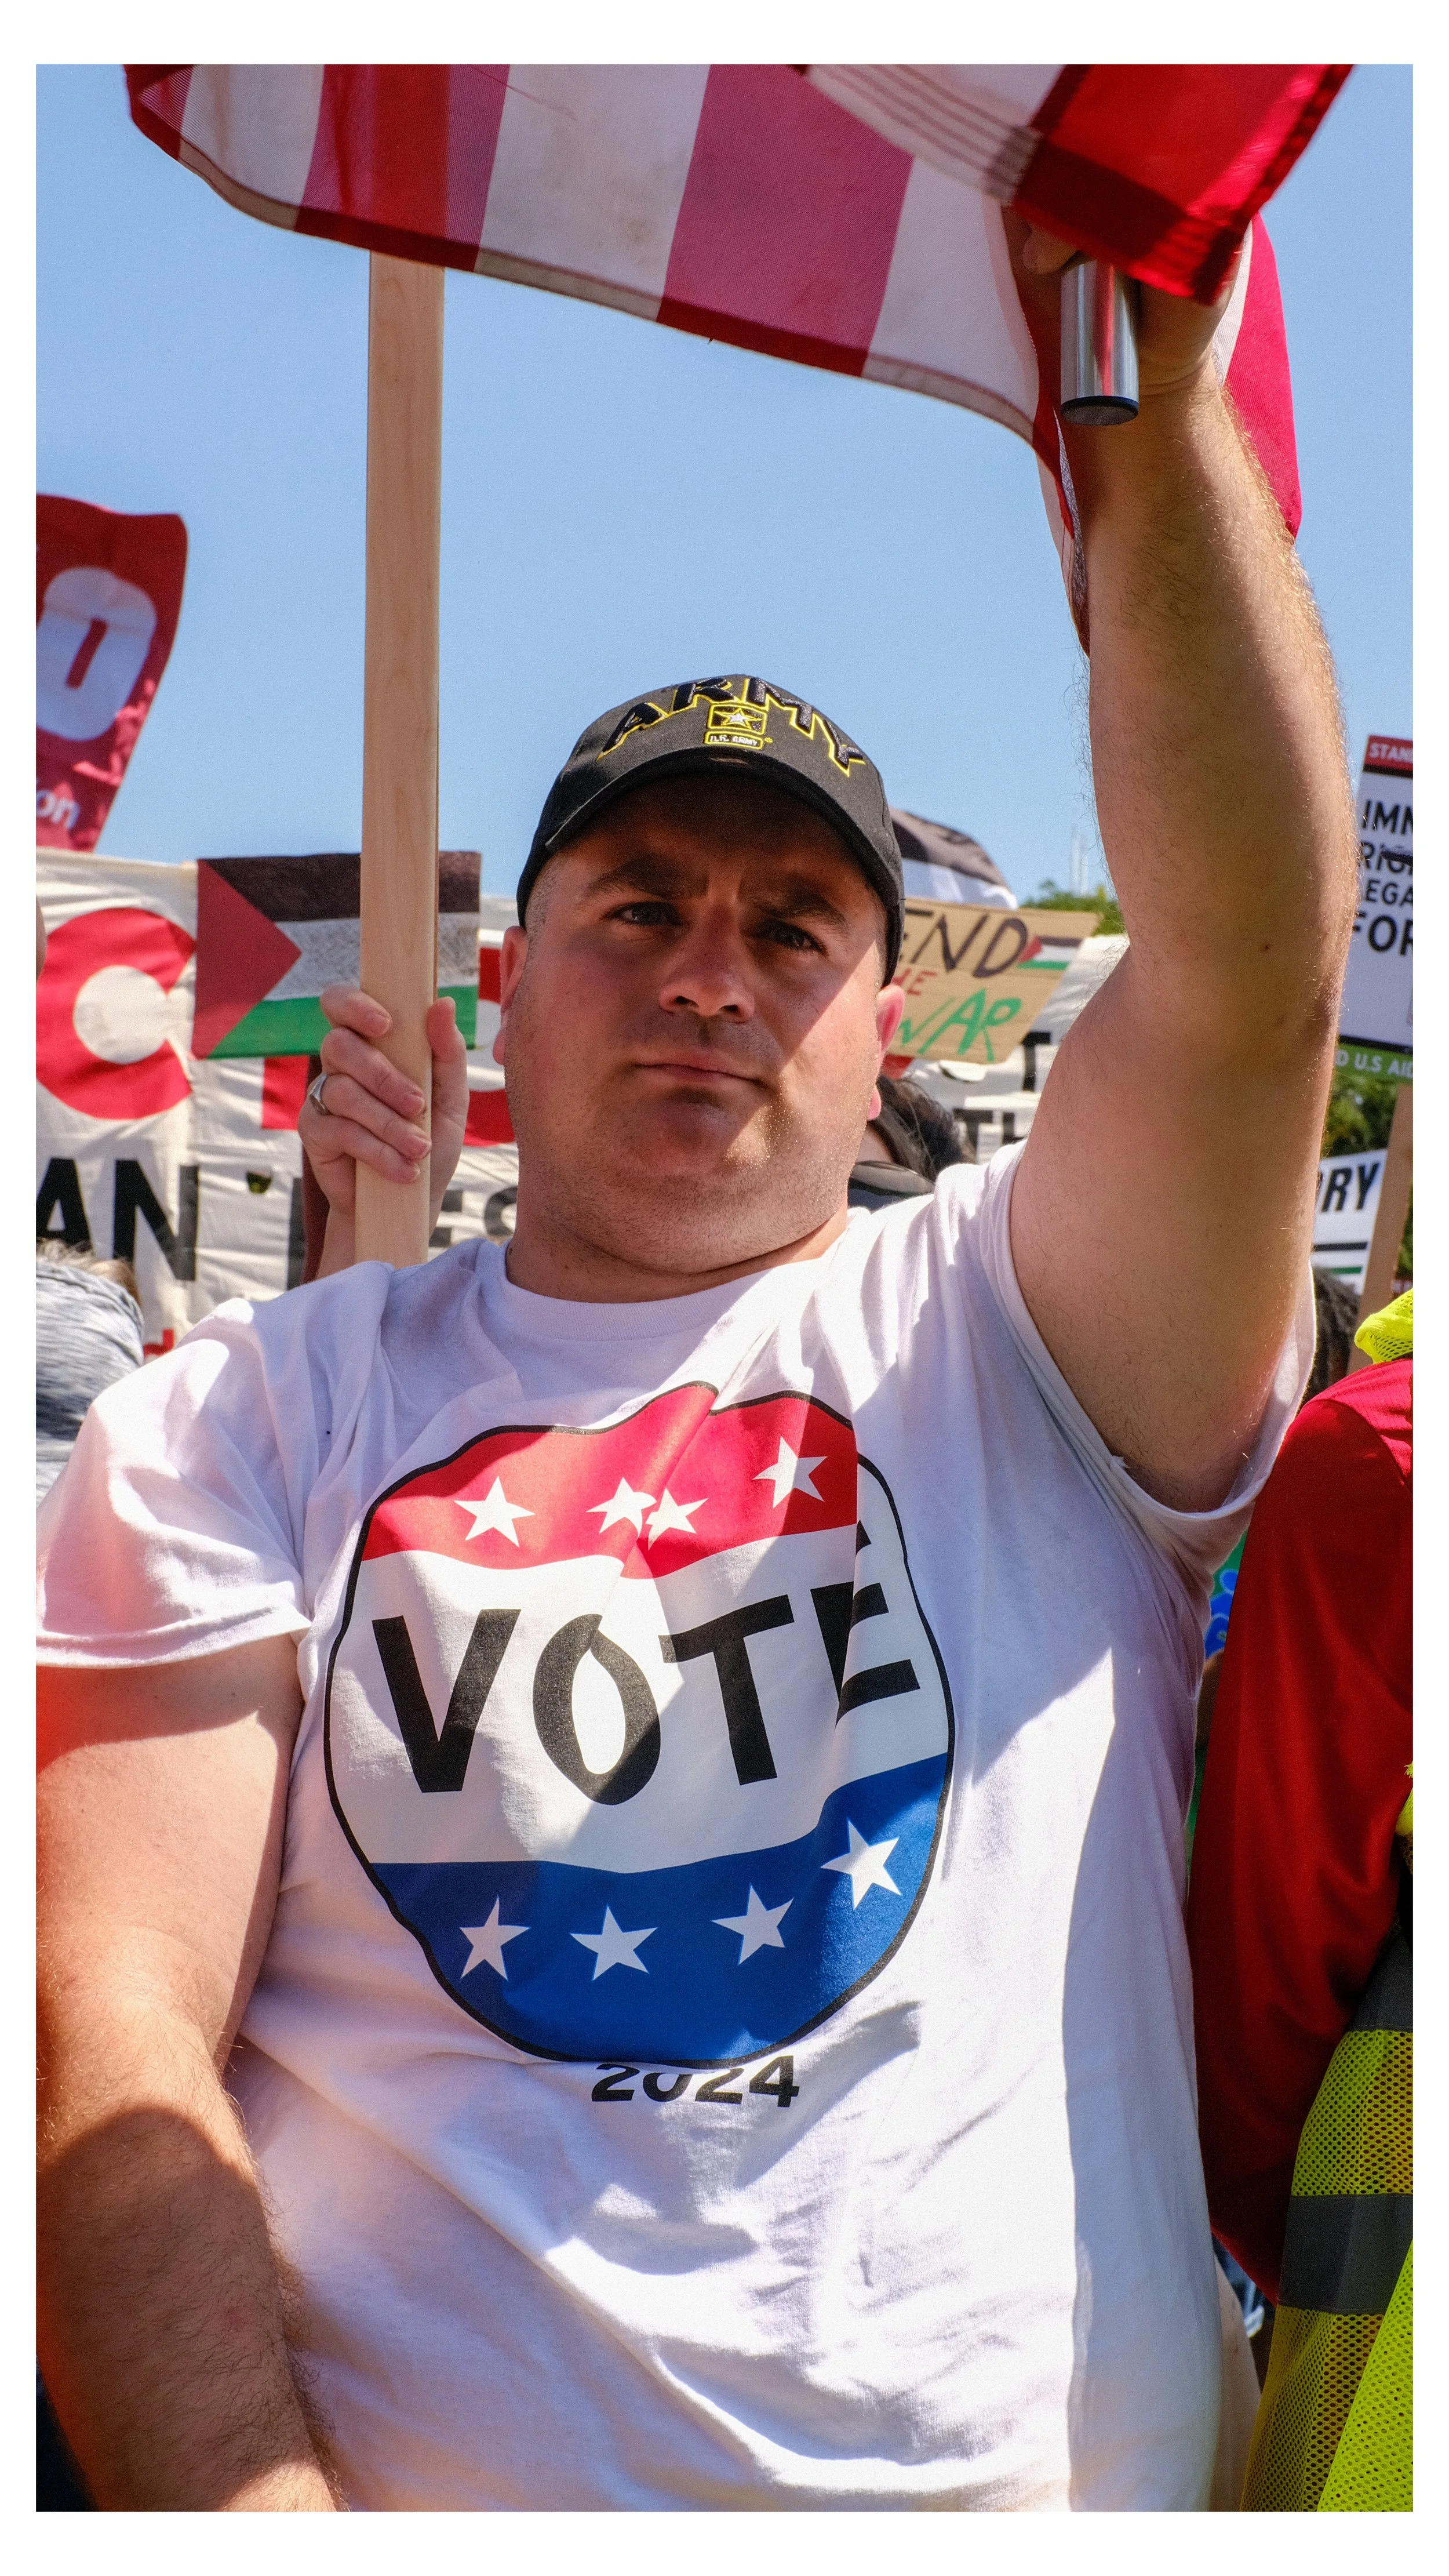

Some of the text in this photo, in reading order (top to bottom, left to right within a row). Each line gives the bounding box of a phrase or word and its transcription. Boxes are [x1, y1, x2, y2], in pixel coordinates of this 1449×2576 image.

[596, 677, 866, 777] ARMY
[732, 736, 758, 746] ARMY
[1360, 841, 1413, 875] RIG
[1318, 1162, 1380, 1213] RY
[372, 1520, 920, 1805] VOTE
[591, 2055, 800, 2107] 2024
